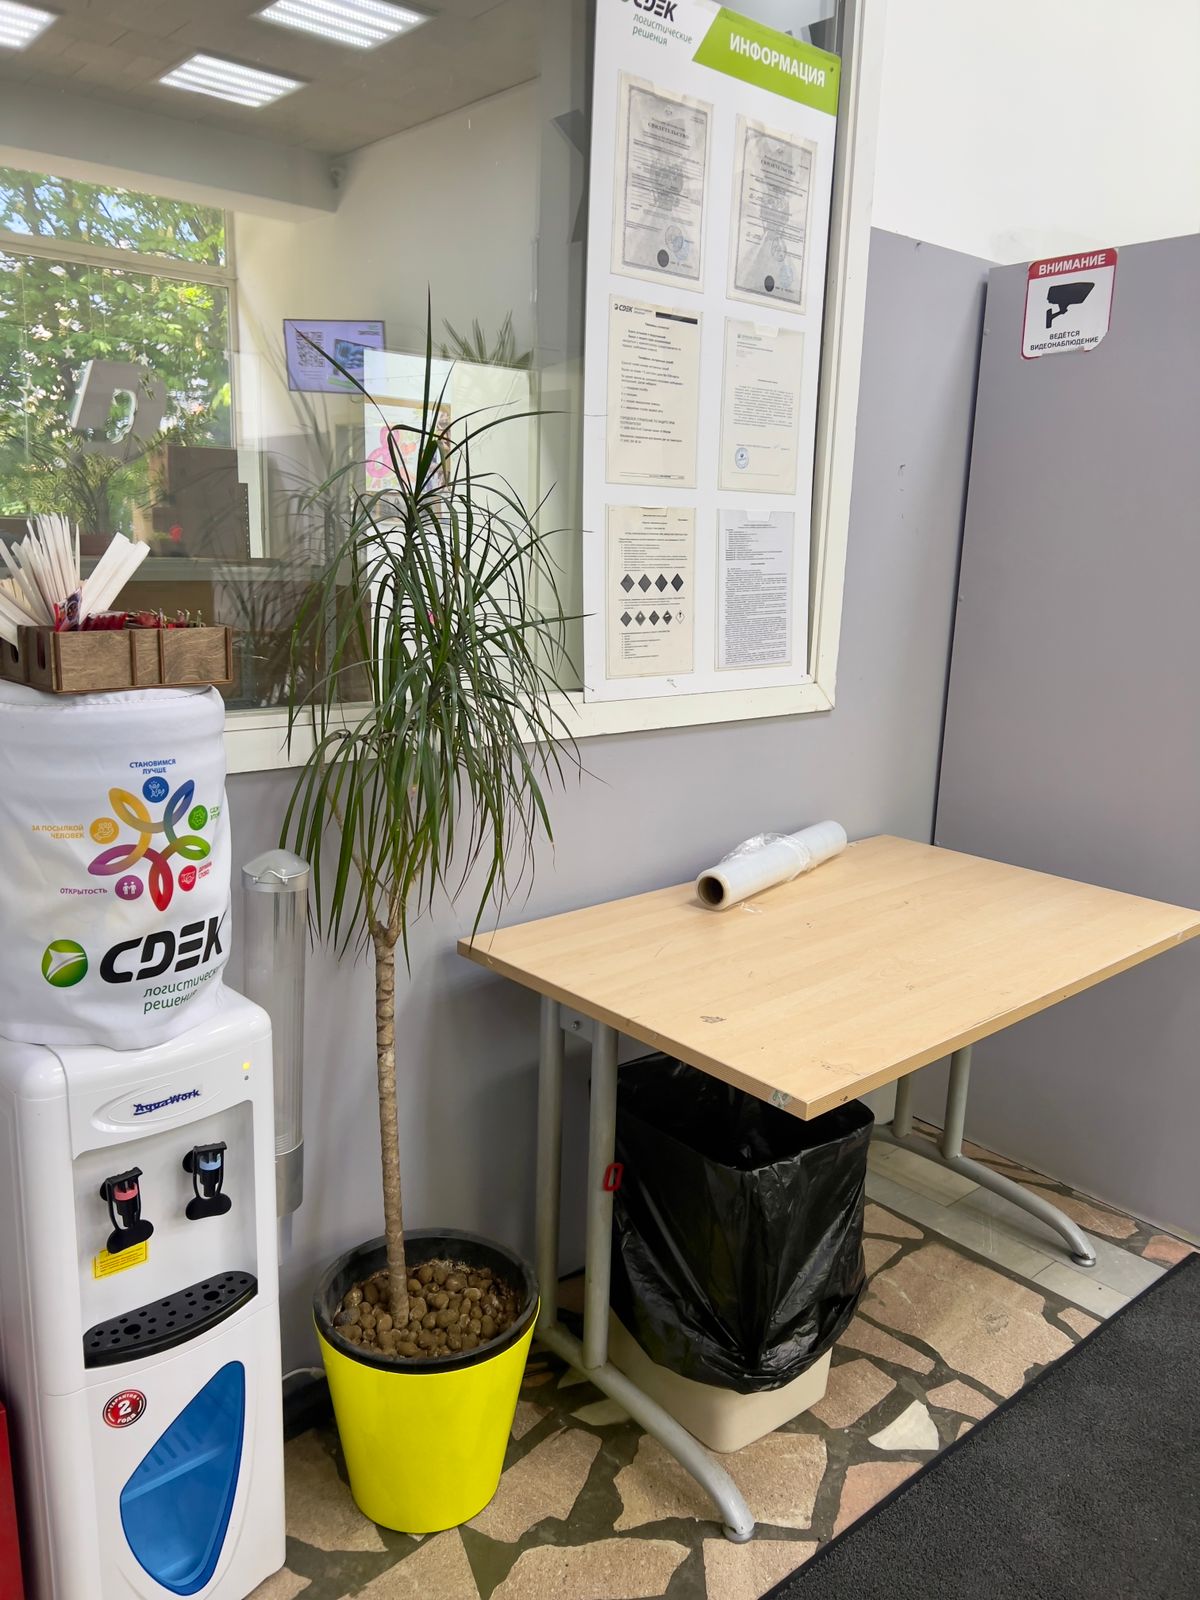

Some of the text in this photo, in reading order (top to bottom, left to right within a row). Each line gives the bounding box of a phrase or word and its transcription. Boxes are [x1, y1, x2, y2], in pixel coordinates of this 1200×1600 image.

[633, 13, 693, 44] логистические
[632, 26, 668, 47] решения
[729, 32, 825, 88] ИНФОРМАЦИЯ
[1038, 254, 1106, 275] ВНИМАНИЕ
[1030, 336, 1099, 351] ВИДЕОНАБЛЮДЕНИЕ
[129, 758, 177, 769] СТАНОВИМСЯ
[142, 767, 167, 775] ЛУЧШЕ
[42, 824, 84, 832] ПОСЫЛКОЙ
[50, 832, 85, 840] ЧЕЛОВЕК
[60, 887, 108, 895] ОТКРЫТОСТЬ
[99, 915, 224, 984] CDEK
[118, 1400, 131, 1416] 2
[117, 1413, 137, 1424] ГОДА
